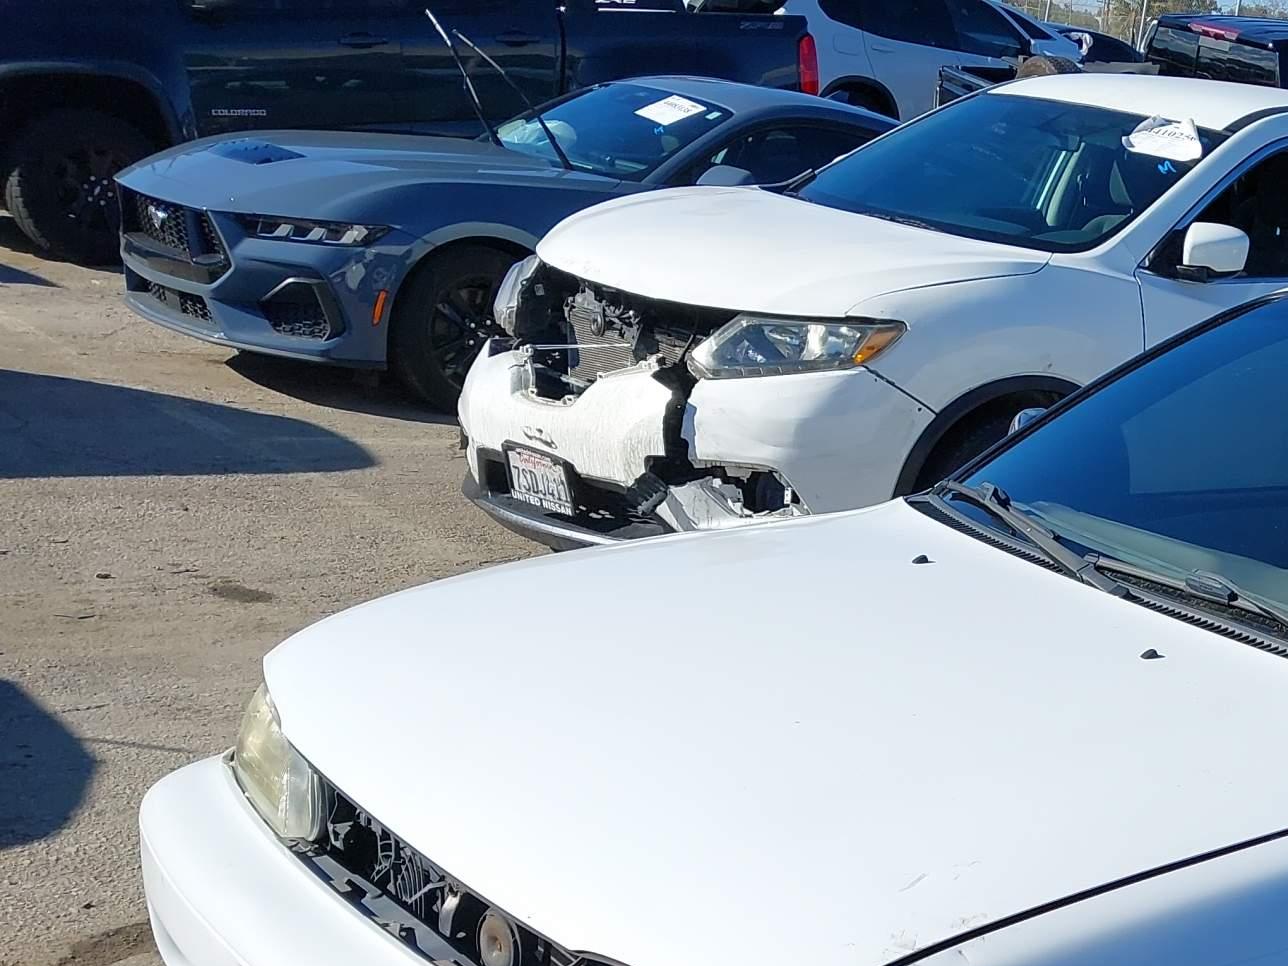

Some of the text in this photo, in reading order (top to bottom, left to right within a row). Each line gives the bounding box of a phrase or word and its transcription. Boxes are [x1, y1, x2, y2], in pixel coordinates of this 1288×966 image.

[1157, 160, 1177, 174] M
[511, 489, 573, 516] UNITED NISSAN
